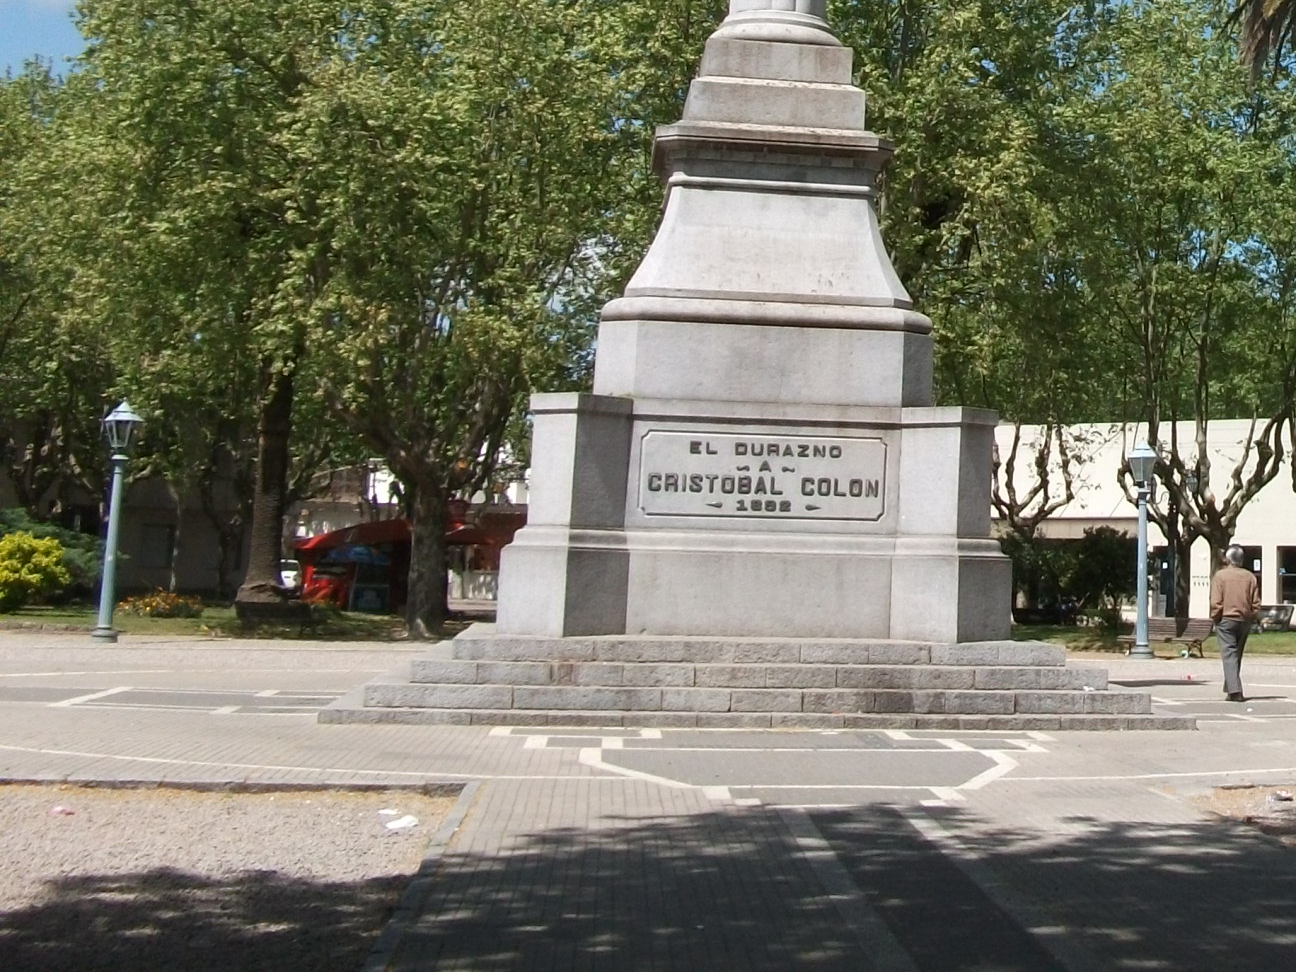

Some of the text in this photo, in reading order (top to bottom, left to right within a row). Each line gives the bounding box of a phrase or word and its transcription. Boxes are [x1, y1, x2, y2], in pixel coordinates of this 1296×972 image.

[689, 440, 843, 459] EL DURAZNO
[757, 460, 772, 472] A
[647, 473, 880, 498] CRISTOBAL COLON
[735, 499, 792, 512] 1892
